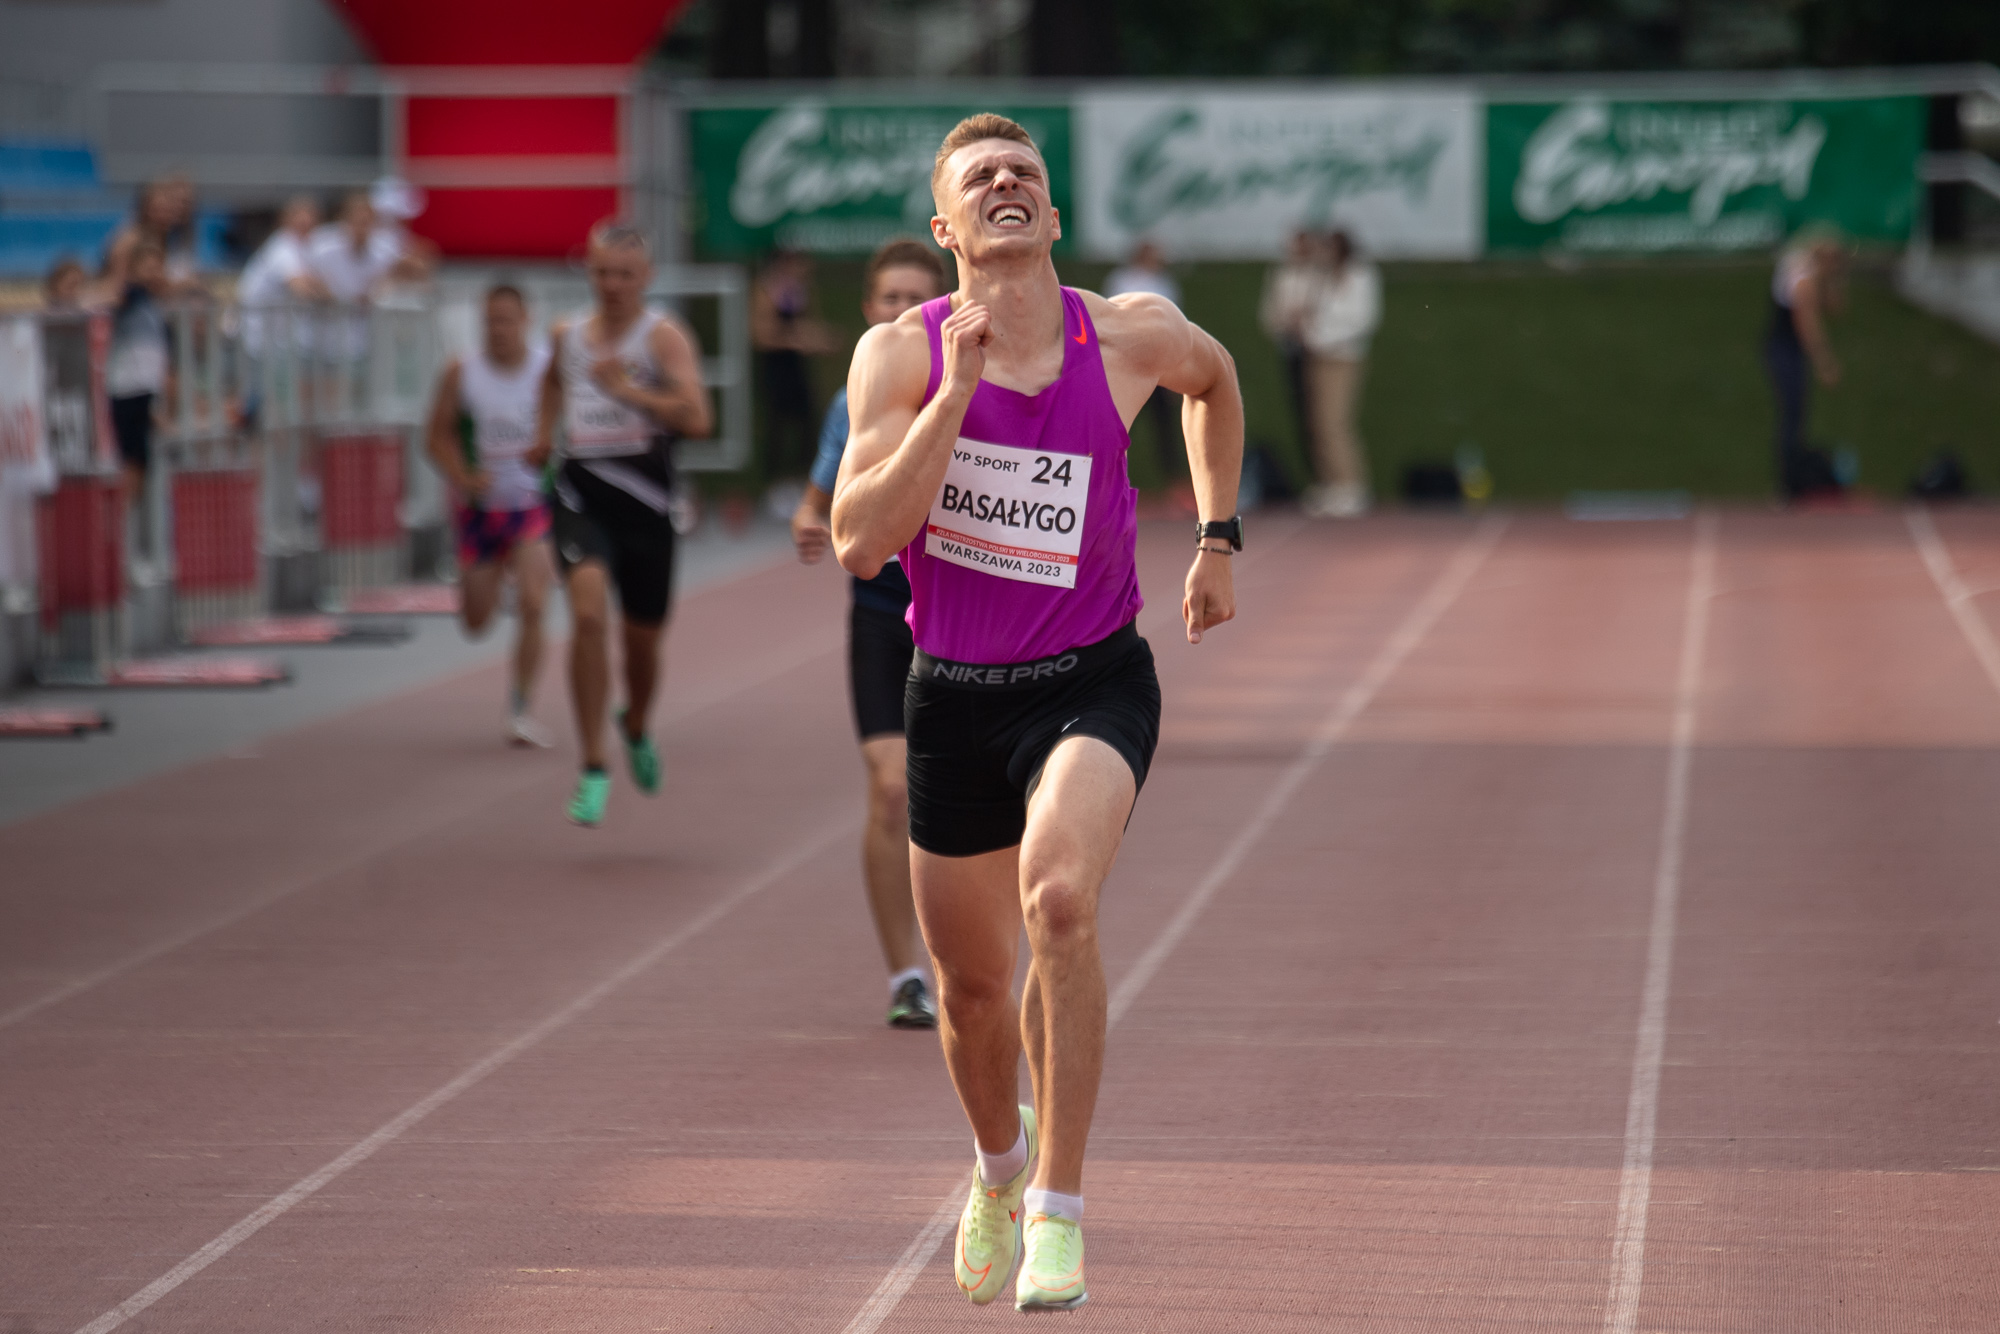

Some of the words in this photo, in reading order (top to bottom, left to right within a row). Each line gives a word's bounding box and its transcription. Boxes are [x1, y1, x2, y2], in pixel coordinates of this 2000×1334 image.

[953, 449, 971, 463] VP
[974, 455, 1020, 473] SPORT
[1031, 456, 1072, 487] 24
[941, 483, 1076, 534] BASAŁYGO
[936, 529, 950, 538] PZLA
[950, 533, 988, 548] MISTRZOSTWA
[988, 545, 1008, 553] POLSKI
[1016, 549, 1056, 560] WIELOBOJACH
[1056, 555, 1070, 563] 2023
[941, 540, 1023, 572] WARSZAWA
[1026, 562, 1061, 577] 2023
[933, 662, 1008, 685] NIKE
[1010, 654, 1079, 684] PRO
